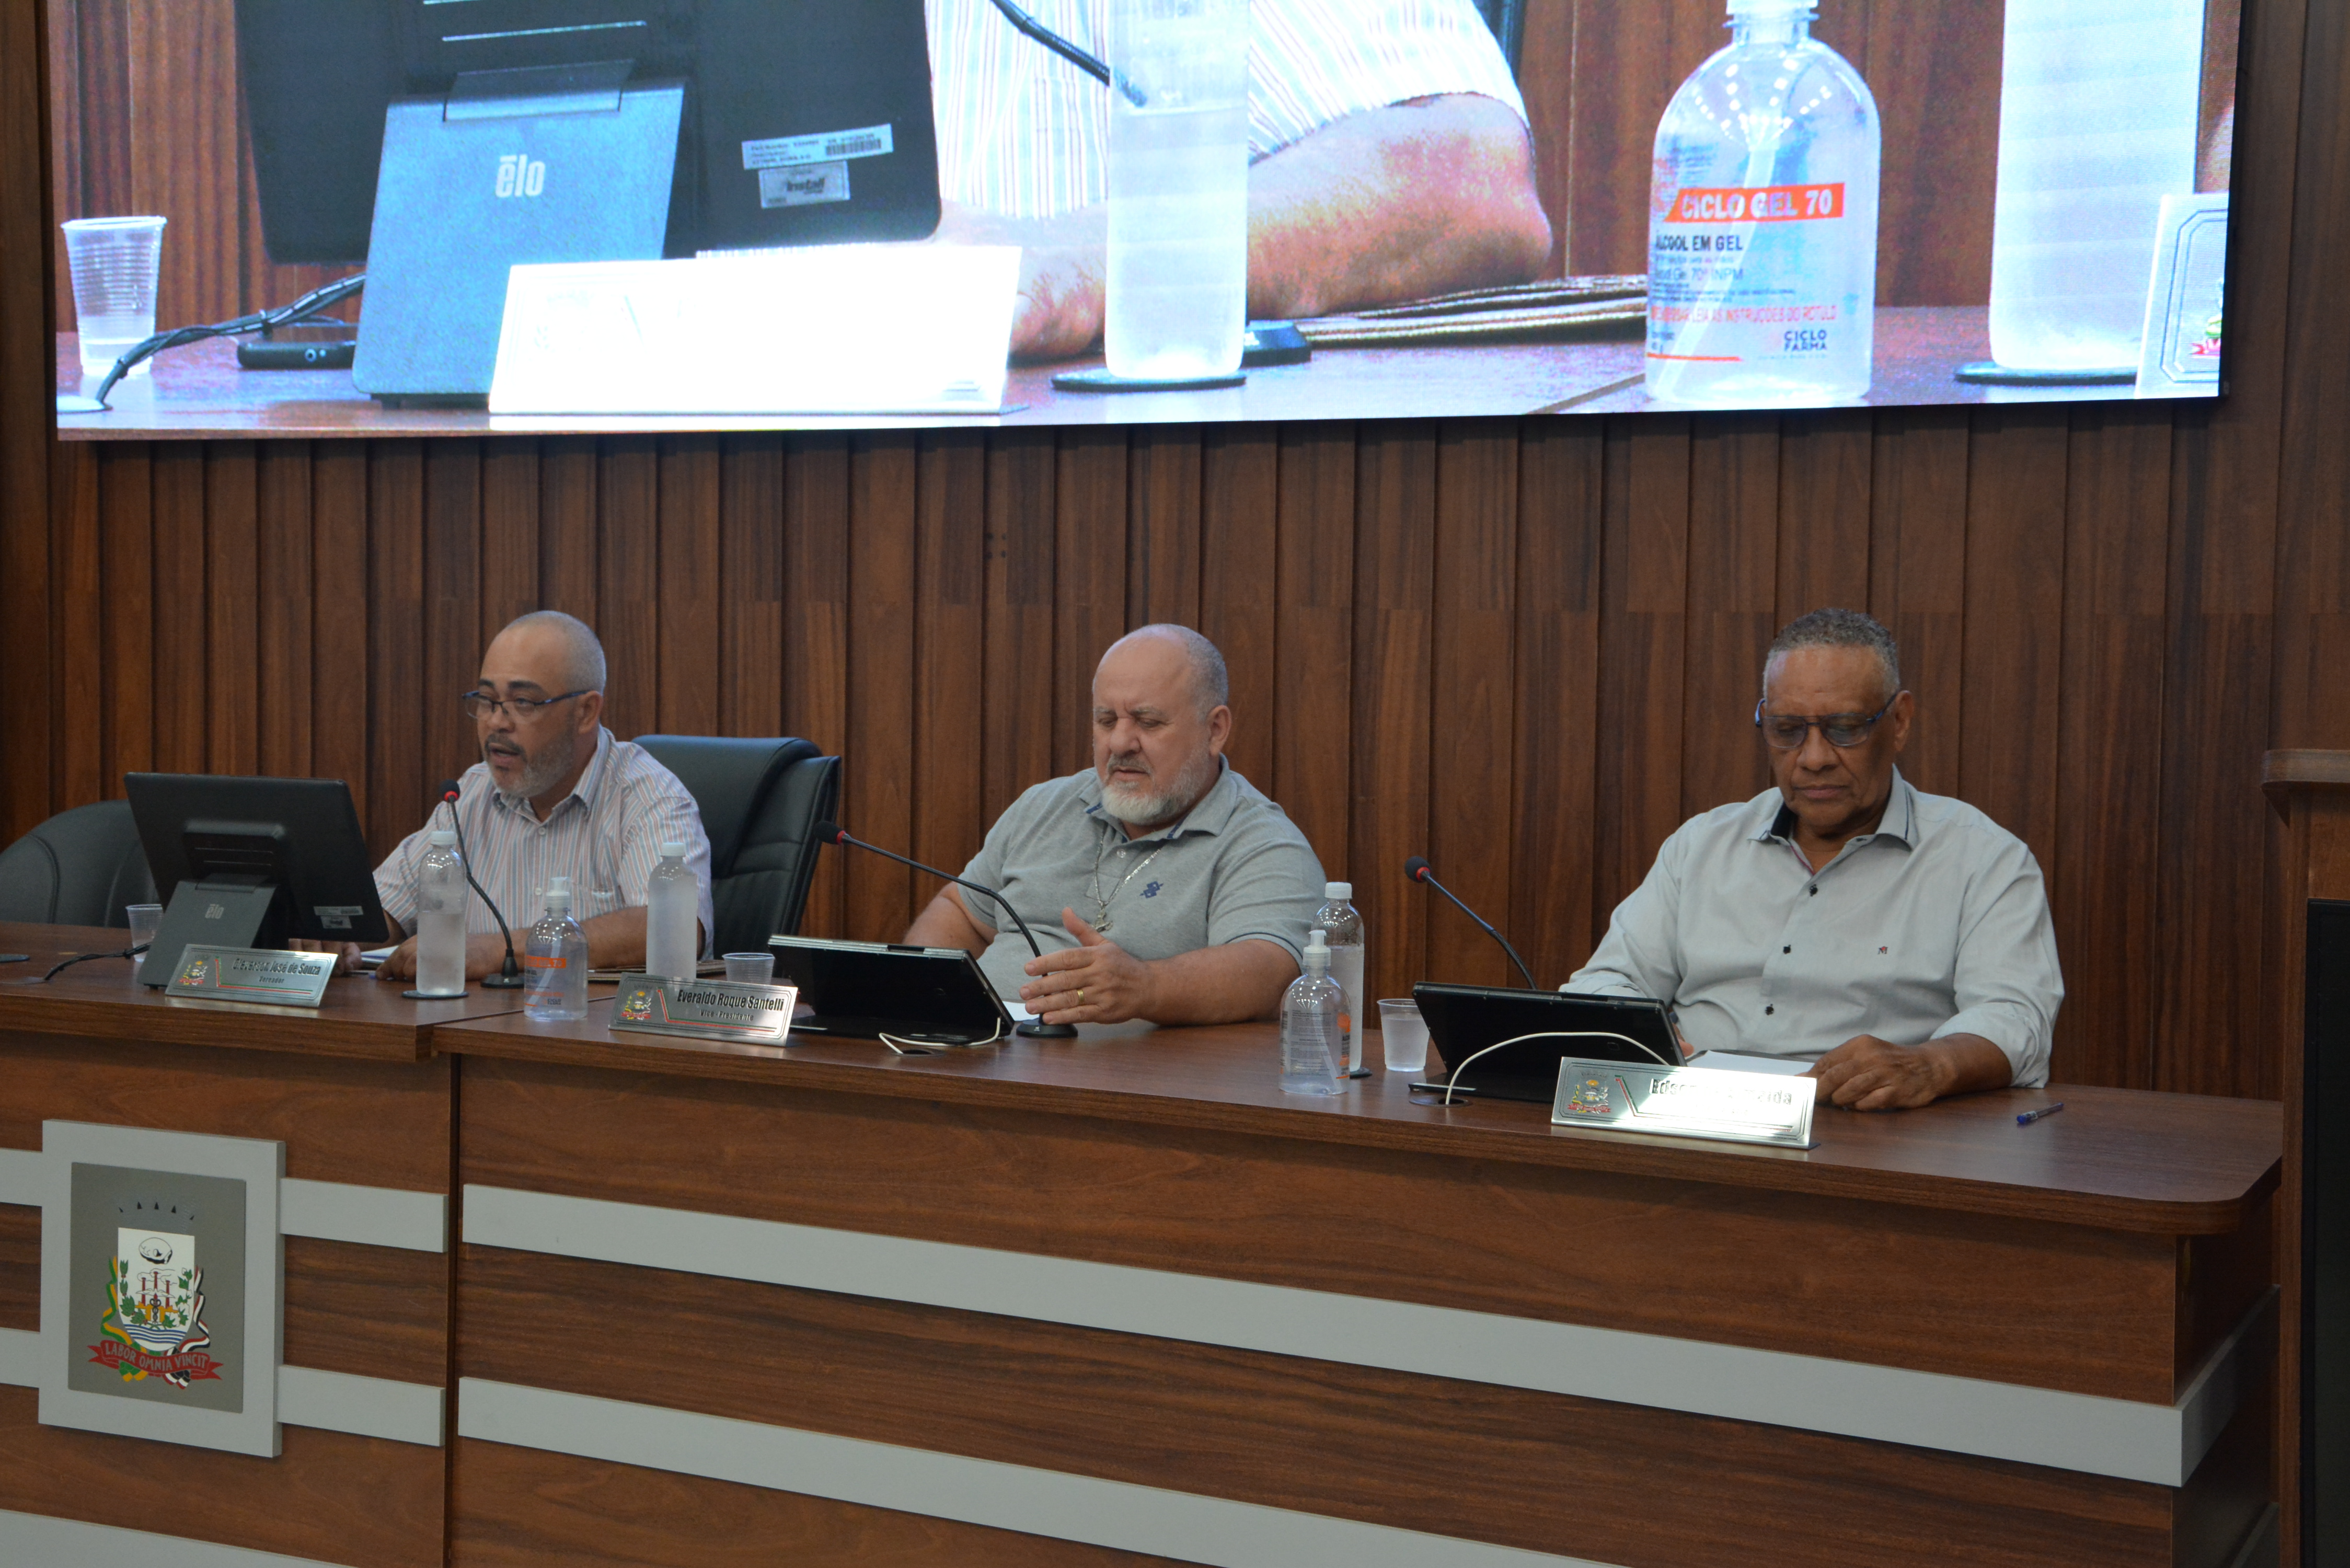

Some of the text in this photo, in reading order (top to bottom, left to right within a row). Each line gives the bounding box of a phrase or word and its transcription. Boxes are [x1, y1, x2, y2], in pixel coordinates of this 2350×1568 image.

[1681, 189, 1833, 219] CICLO GEL 70
[1692, 235, 1711, 251] EM
[1715, 235, 1743, 251] GEL
[1784, 330, 1827, 340] CICLO
[1784, 341, 1827, 351] FARMA
[270, 961, 289, 973] José
[287, 962, 298, 974] de
[297, 963, 321, 976] Souza
[677, 989, 785, 1011] Everaldo Roque Santelli
[718, 1011, 754, 1021] Presidente
[105, 1343, 209, 1371] LABOR OMNIA VINCIT
